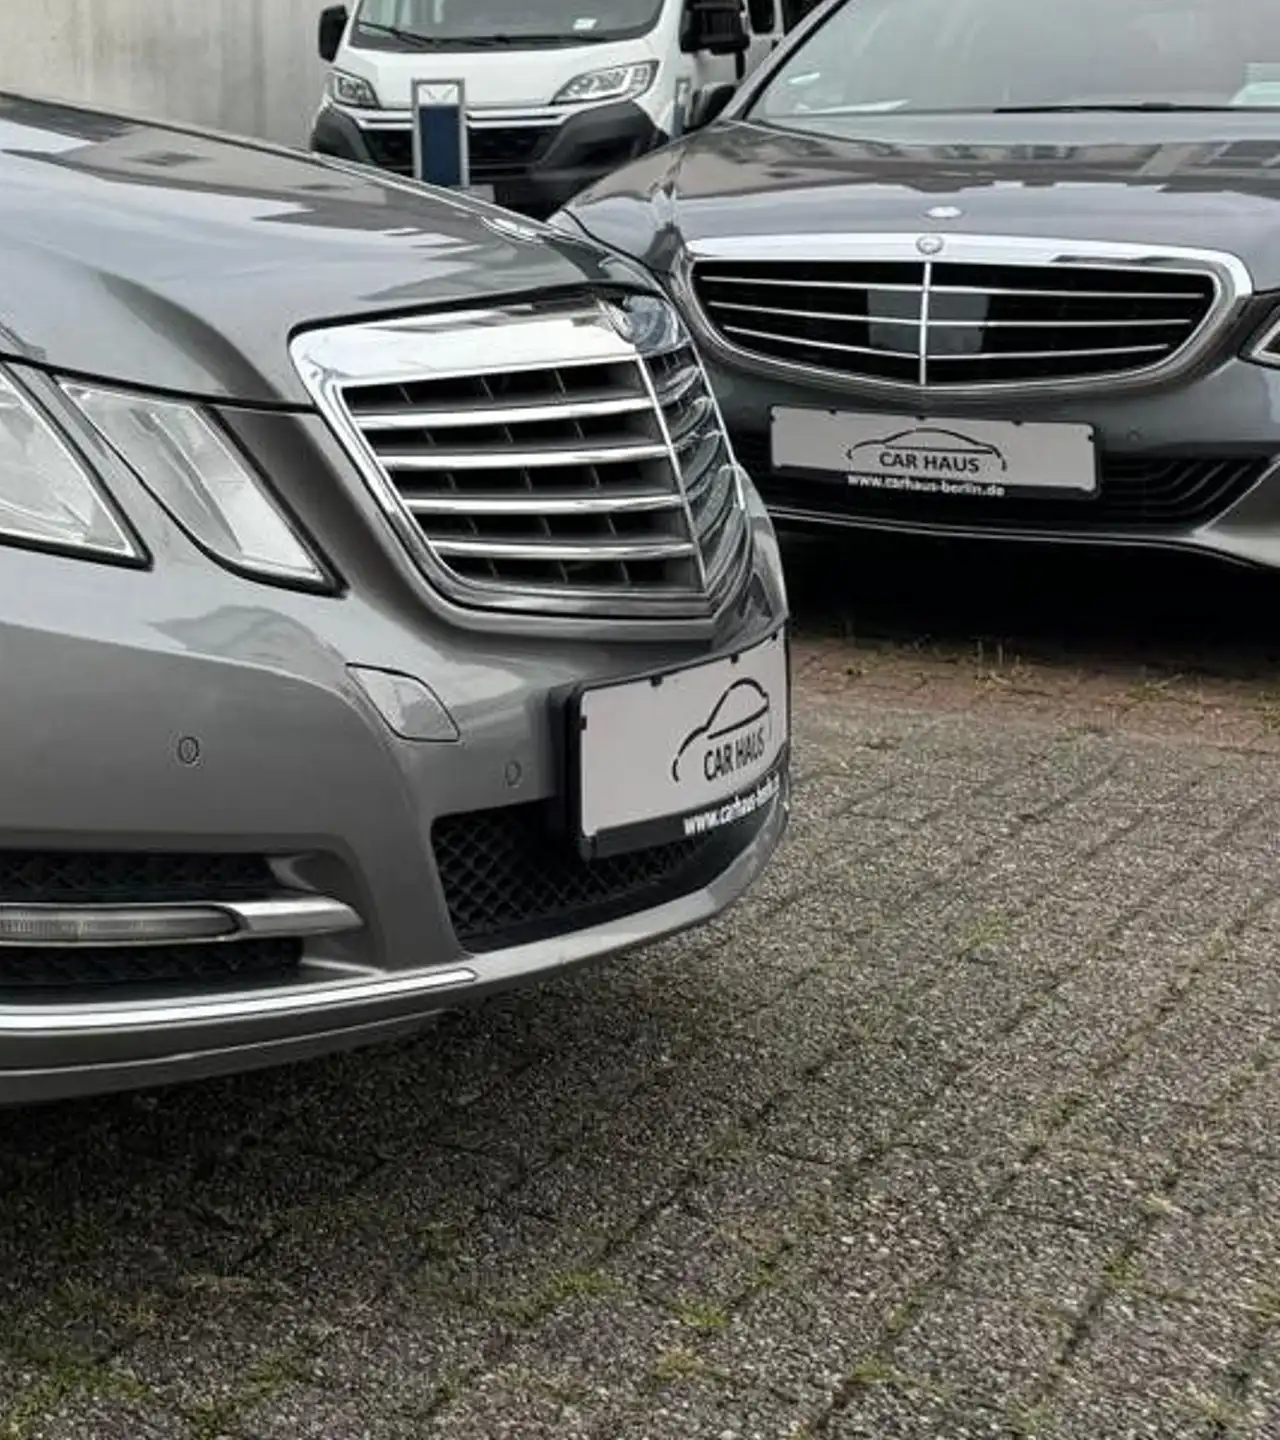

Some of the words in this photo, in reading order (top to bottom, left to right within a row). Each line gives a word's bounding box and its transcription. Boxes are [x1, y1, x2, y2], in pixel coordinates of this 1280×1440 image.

[878, 451, 918, 470] CAR
[923, 455, 980, 474] HAUS
[847, 474, 1006, 498] www.carhaus-berlin.de
[703, 743, 733, 782] CAR
